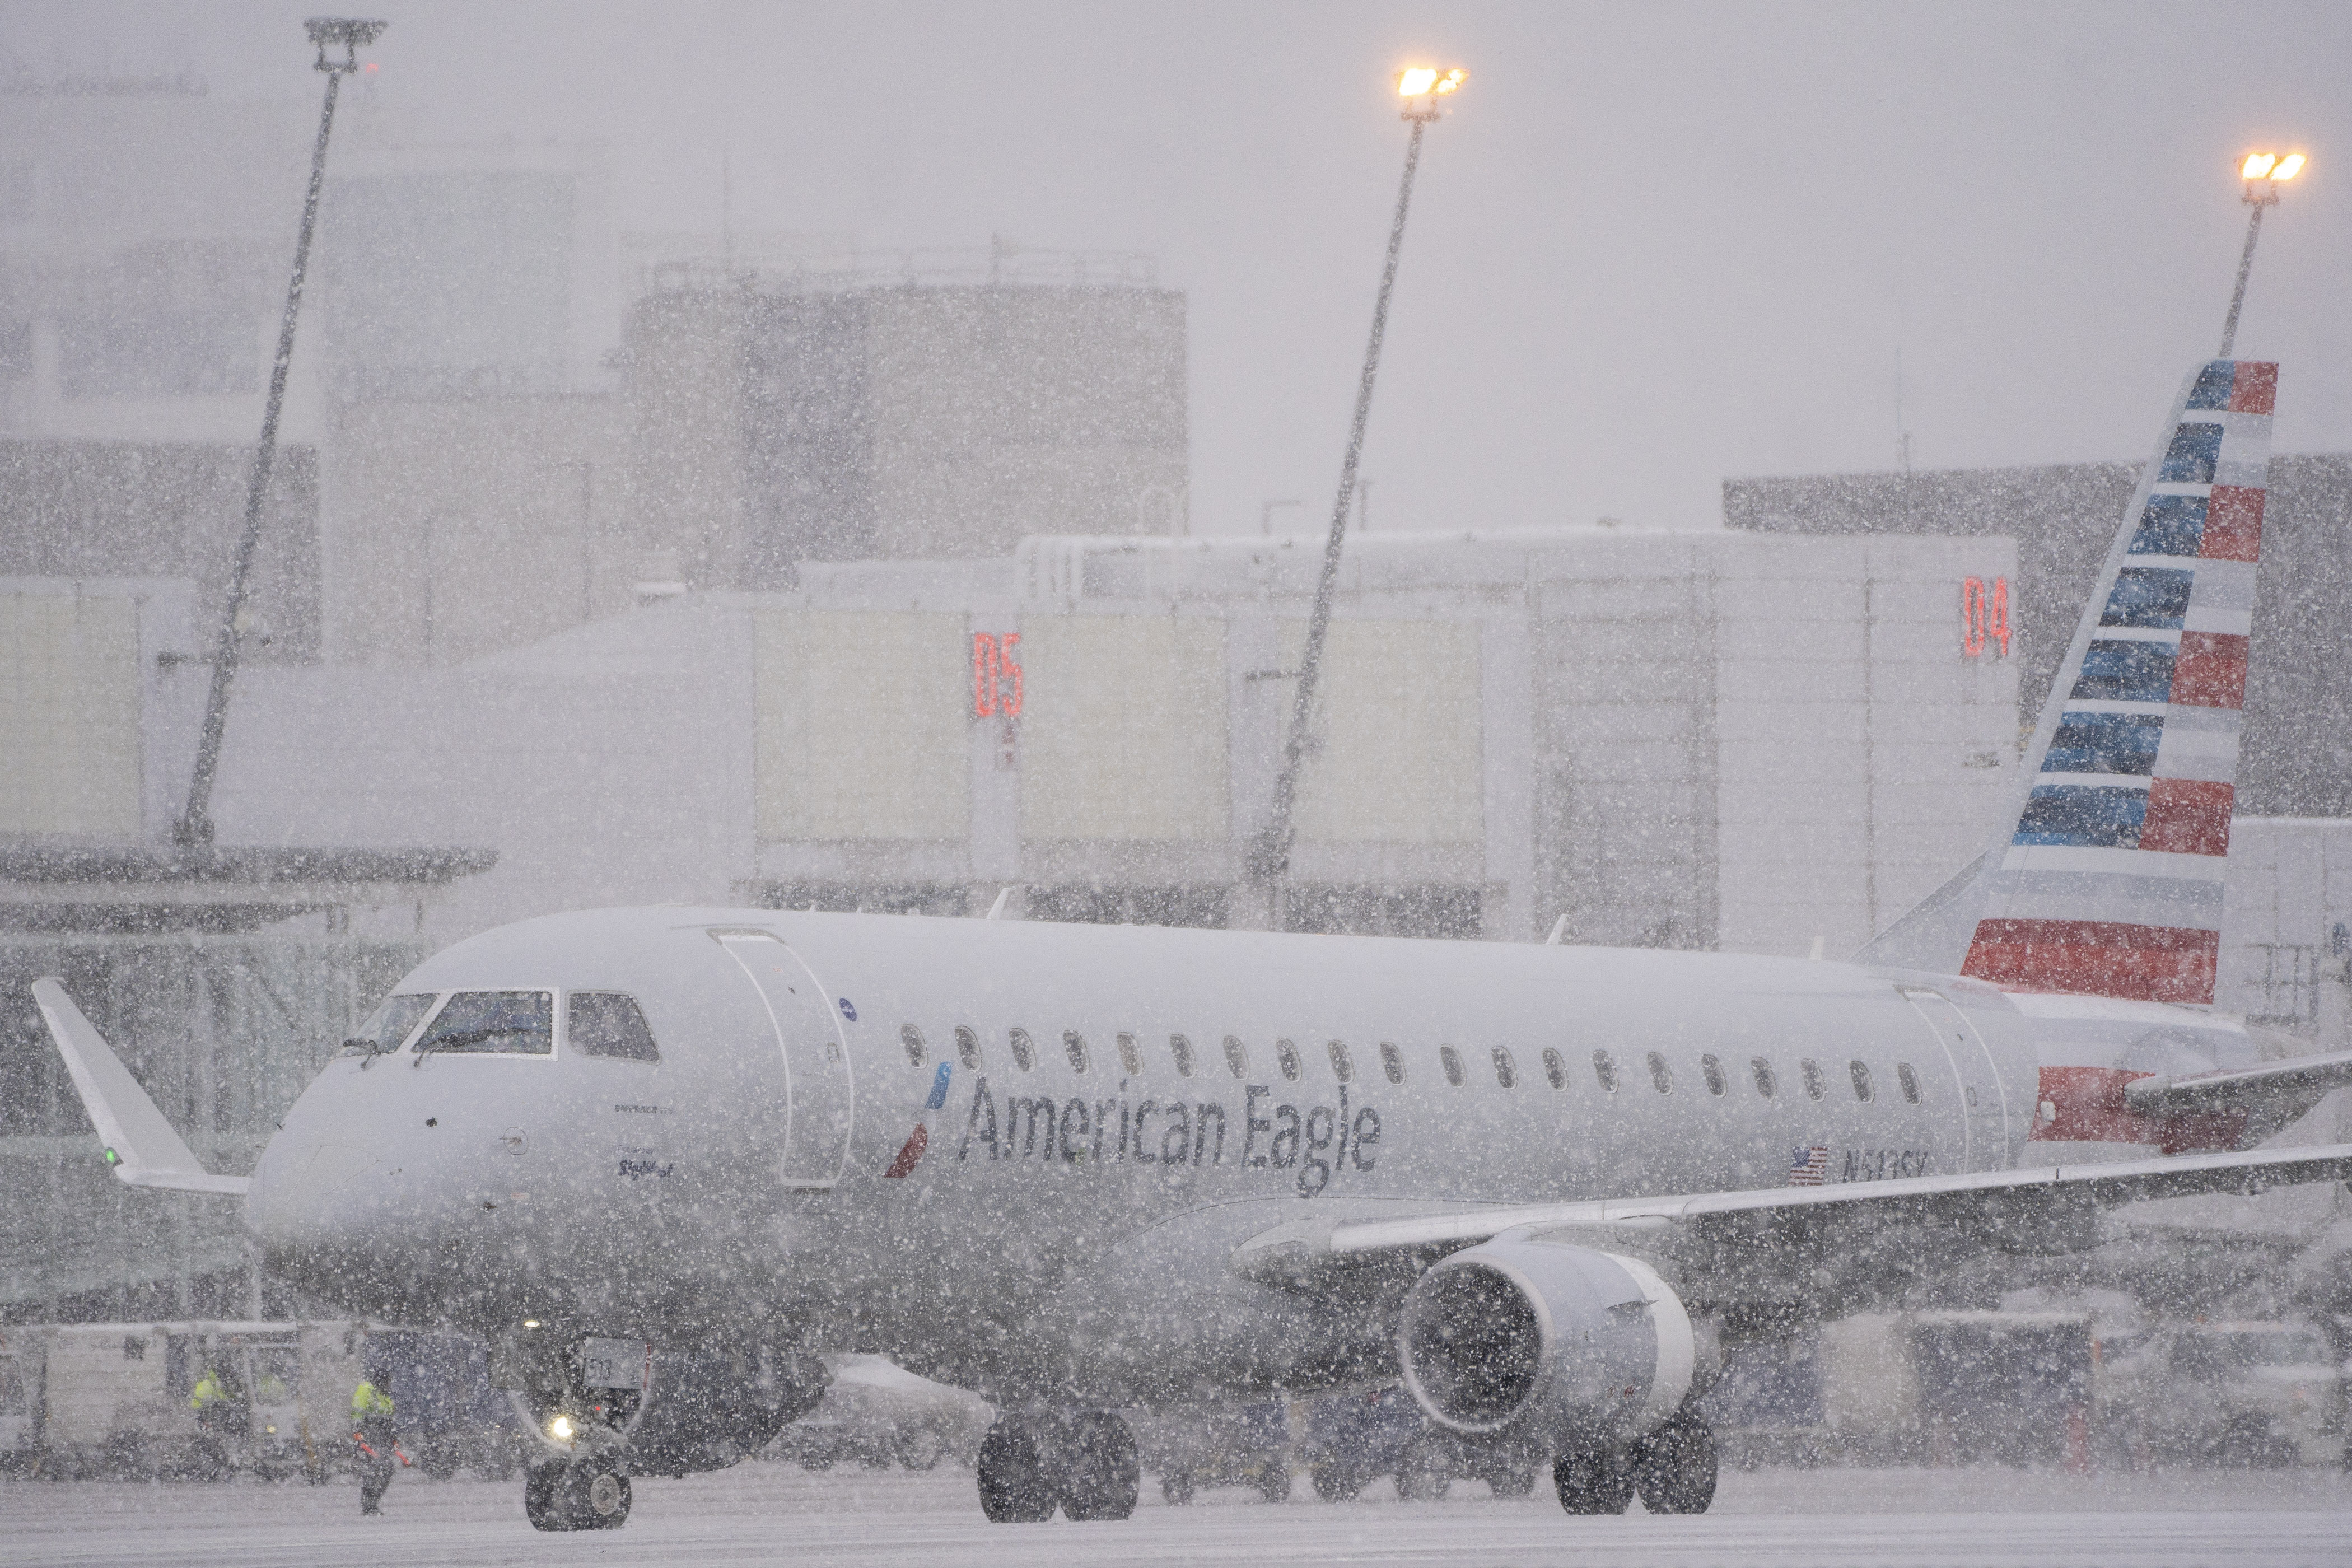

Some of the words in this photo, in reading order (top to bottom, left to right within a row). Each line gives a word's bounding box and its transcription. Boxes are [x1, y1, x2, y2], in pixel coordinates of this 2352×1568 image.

[1964, 576, 2012, 657] D4
[974, 632, 1023, 717] D5
[959, 1076, 1226, 1166] American
[1242, 1085, 1381, 1199] Eagle
